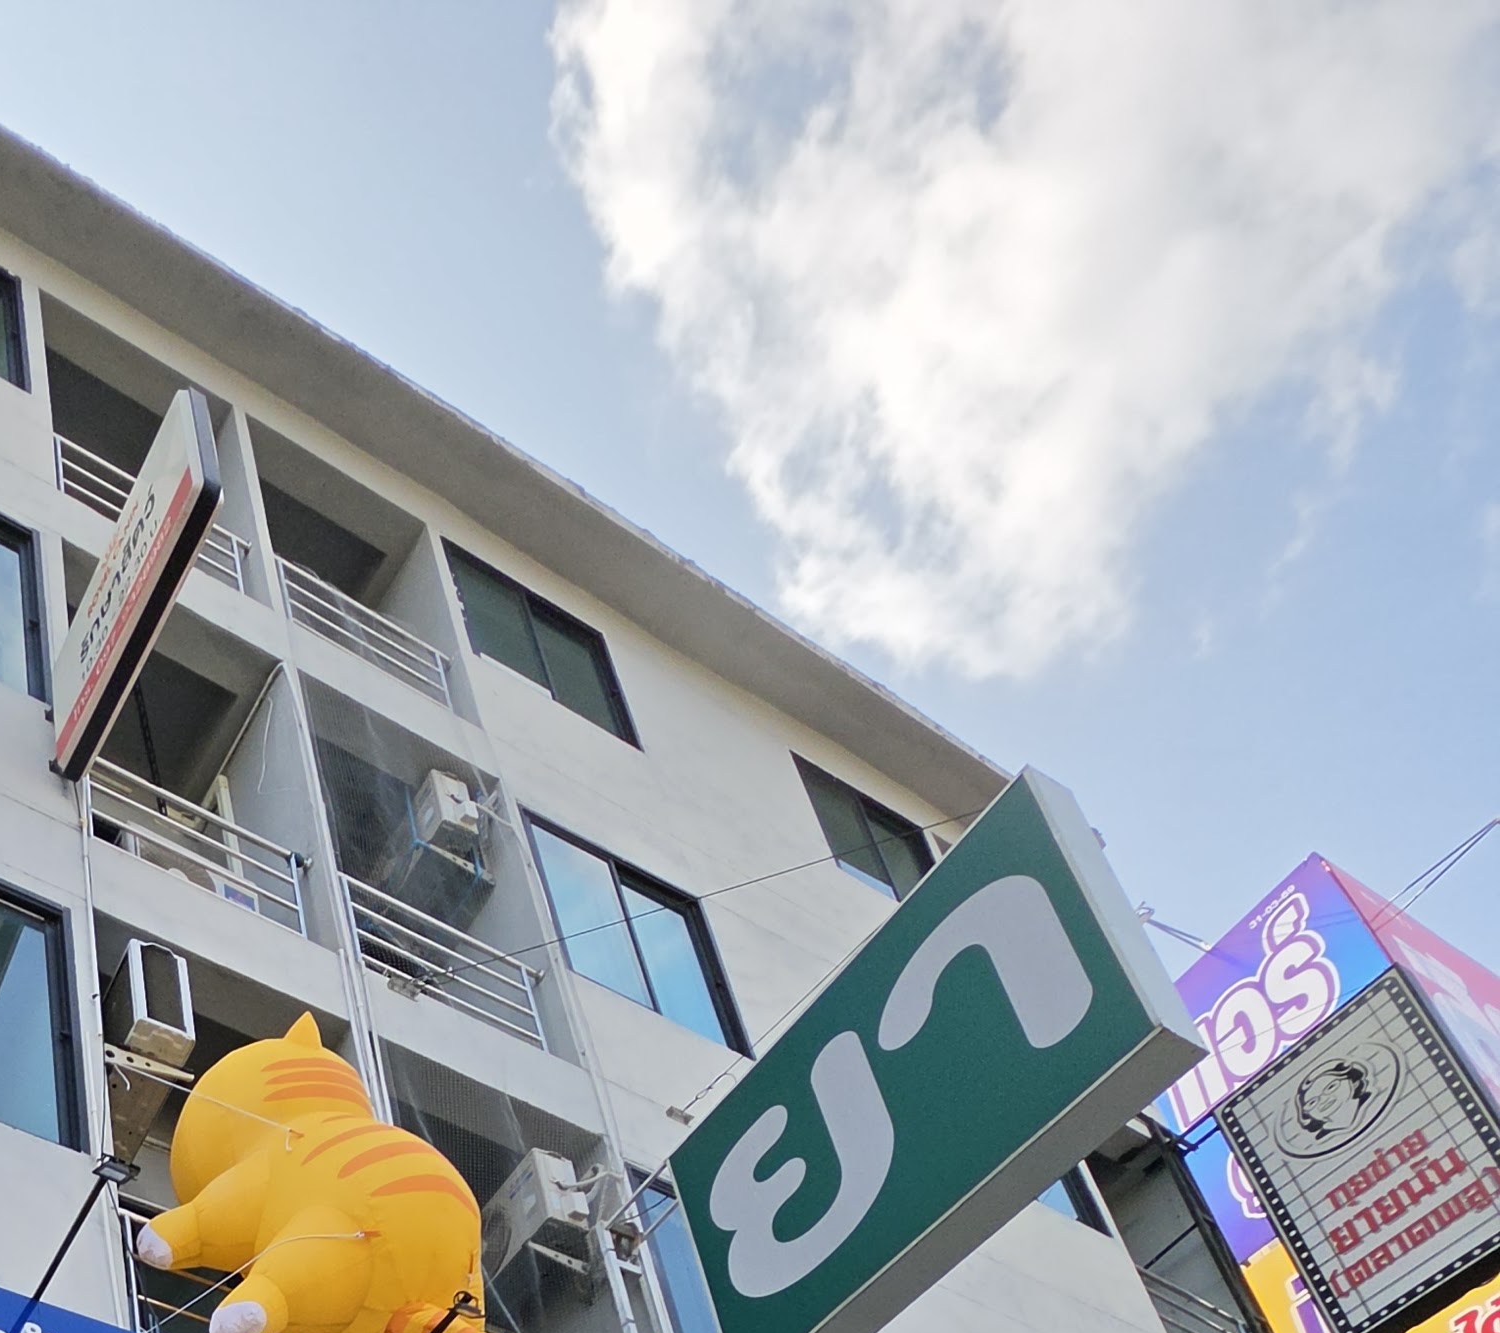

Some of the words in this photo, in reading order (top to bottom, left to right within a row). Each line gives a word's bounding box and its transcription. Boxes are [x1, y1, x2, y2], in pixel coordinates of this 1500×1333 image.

[80, 483, 155, 663] รักษาสัตว์
[710, 874, 1094, 1298] ยา
[1326, 1129, 1429, 1211] กุยช่าย
